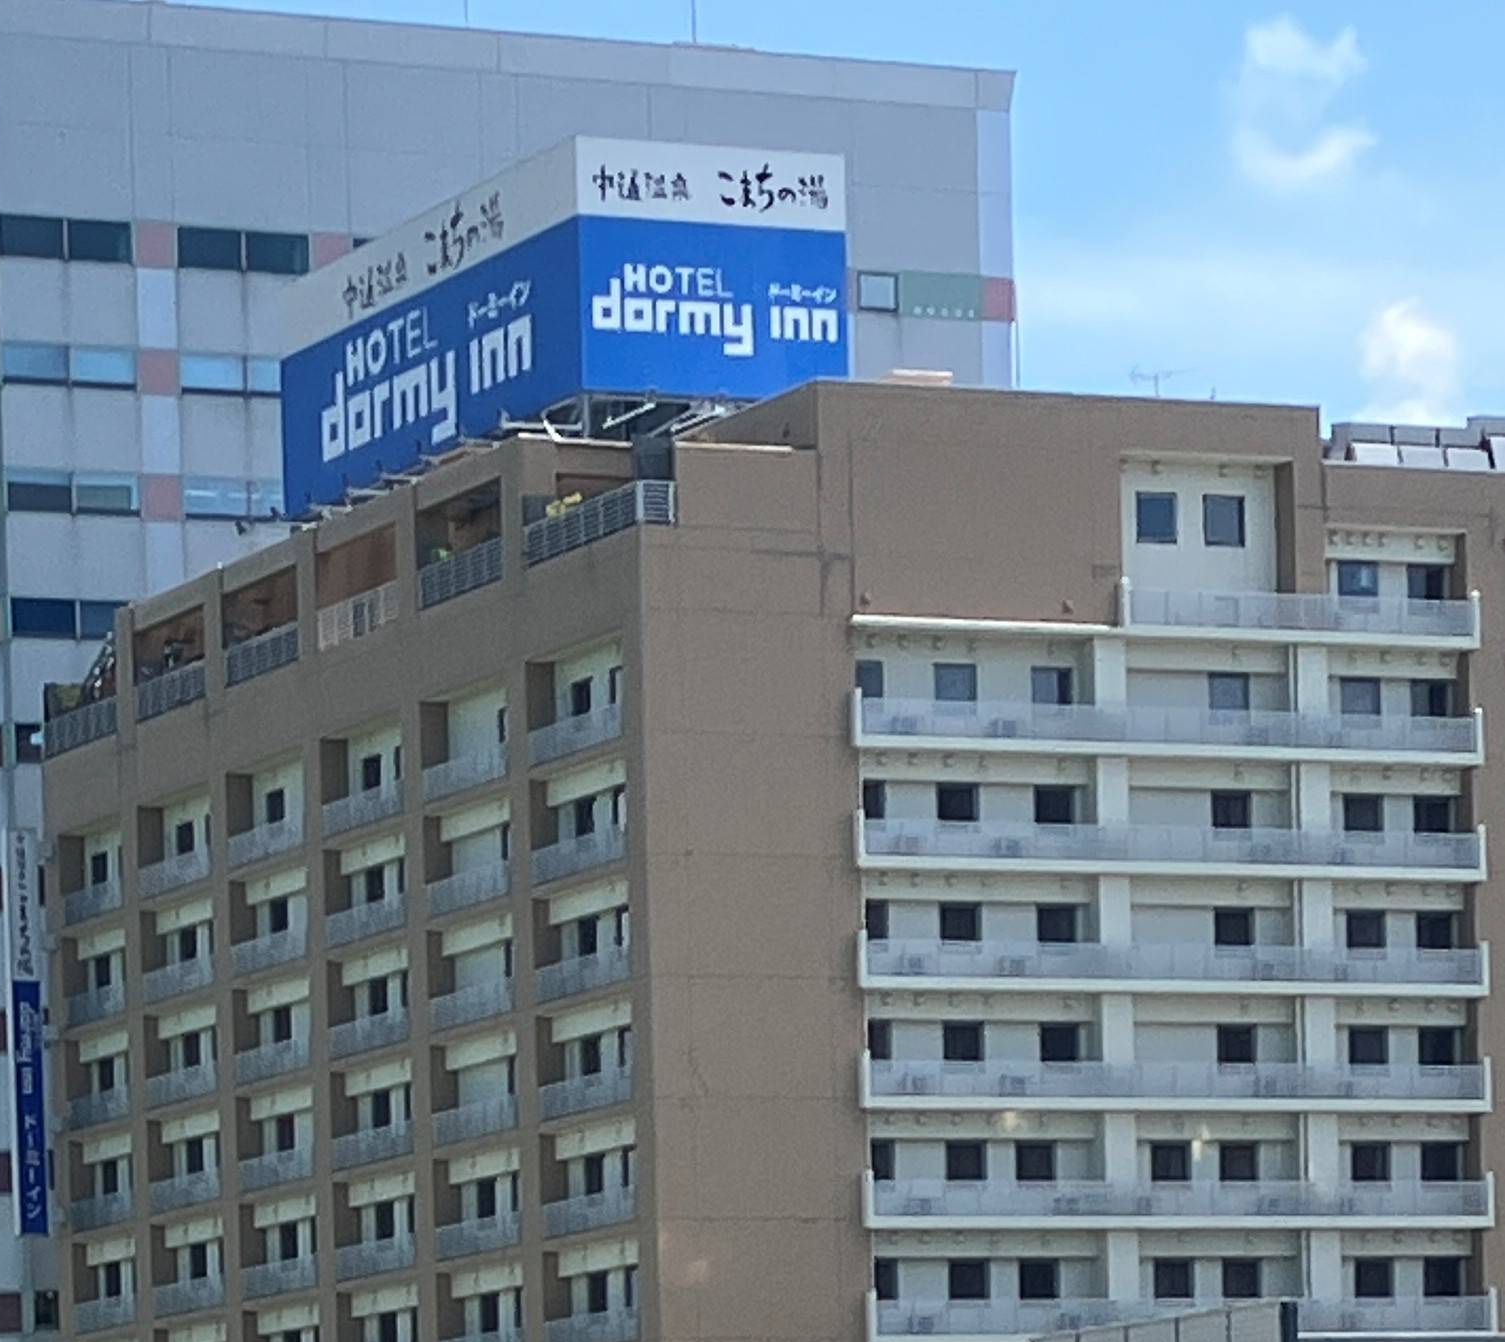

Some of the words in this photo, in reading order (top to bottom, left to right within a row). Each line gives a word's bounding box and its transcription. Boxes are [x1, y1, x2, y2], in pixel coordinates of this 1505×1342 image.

[592, 164, 692, 201] 中通温泉
[717, 162, 829, 213] こまちの湯
[592, 277, 755, 358] dormy
[769, 304, 839, 344] inn
[623, 262, 734, 298] HOTEL
[345, 306, 439, 388] HOTEL
[321, 350, 457, 463] dormy
[469, 313, 533, 396] inn
